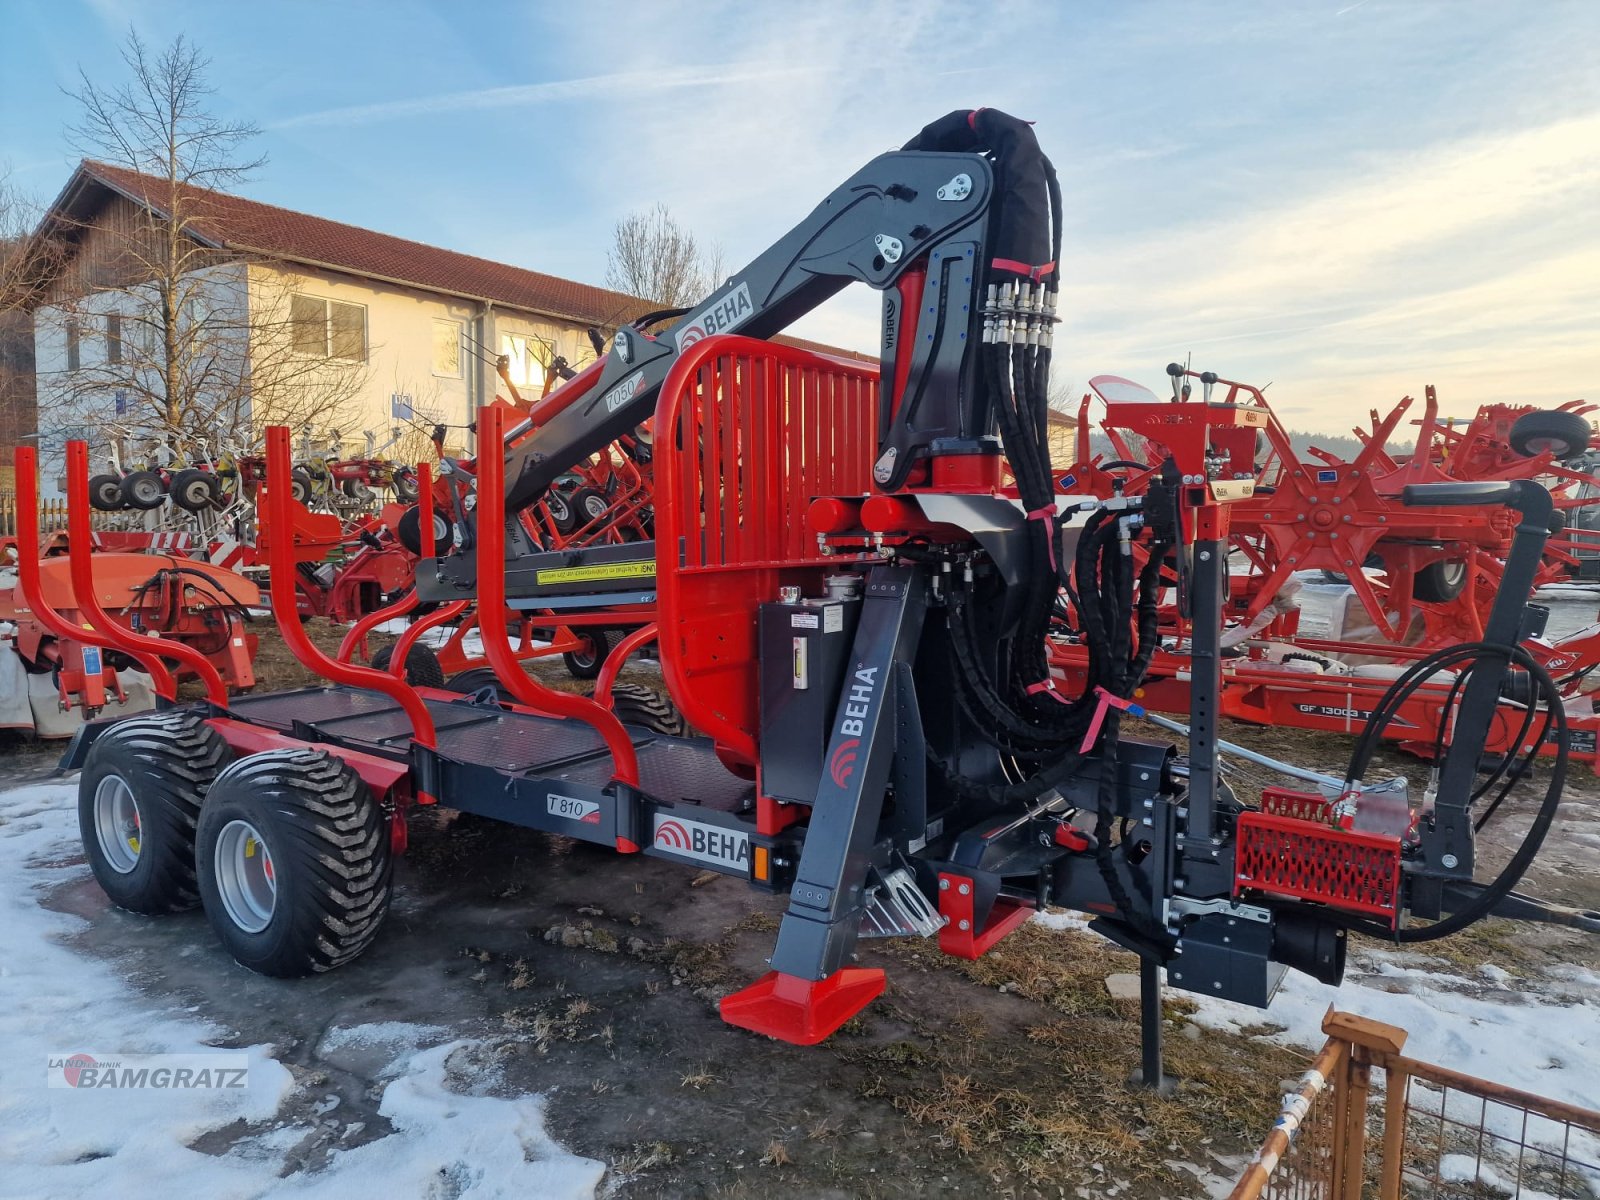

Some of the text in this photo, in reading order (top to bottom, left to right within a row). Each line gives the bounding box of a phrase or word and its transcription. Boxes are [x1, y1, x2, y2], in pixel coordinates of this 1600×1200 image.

[886, 319, 895, 350] BEHA
[606, 380, 635, 409] 7050
[641, 564, 656, 573] UNG!
[1300, 704, 1372, 719] GF 13003 T
[549, 797, 583, 816] T 810
[692, 828, 749, 863] BEHA
